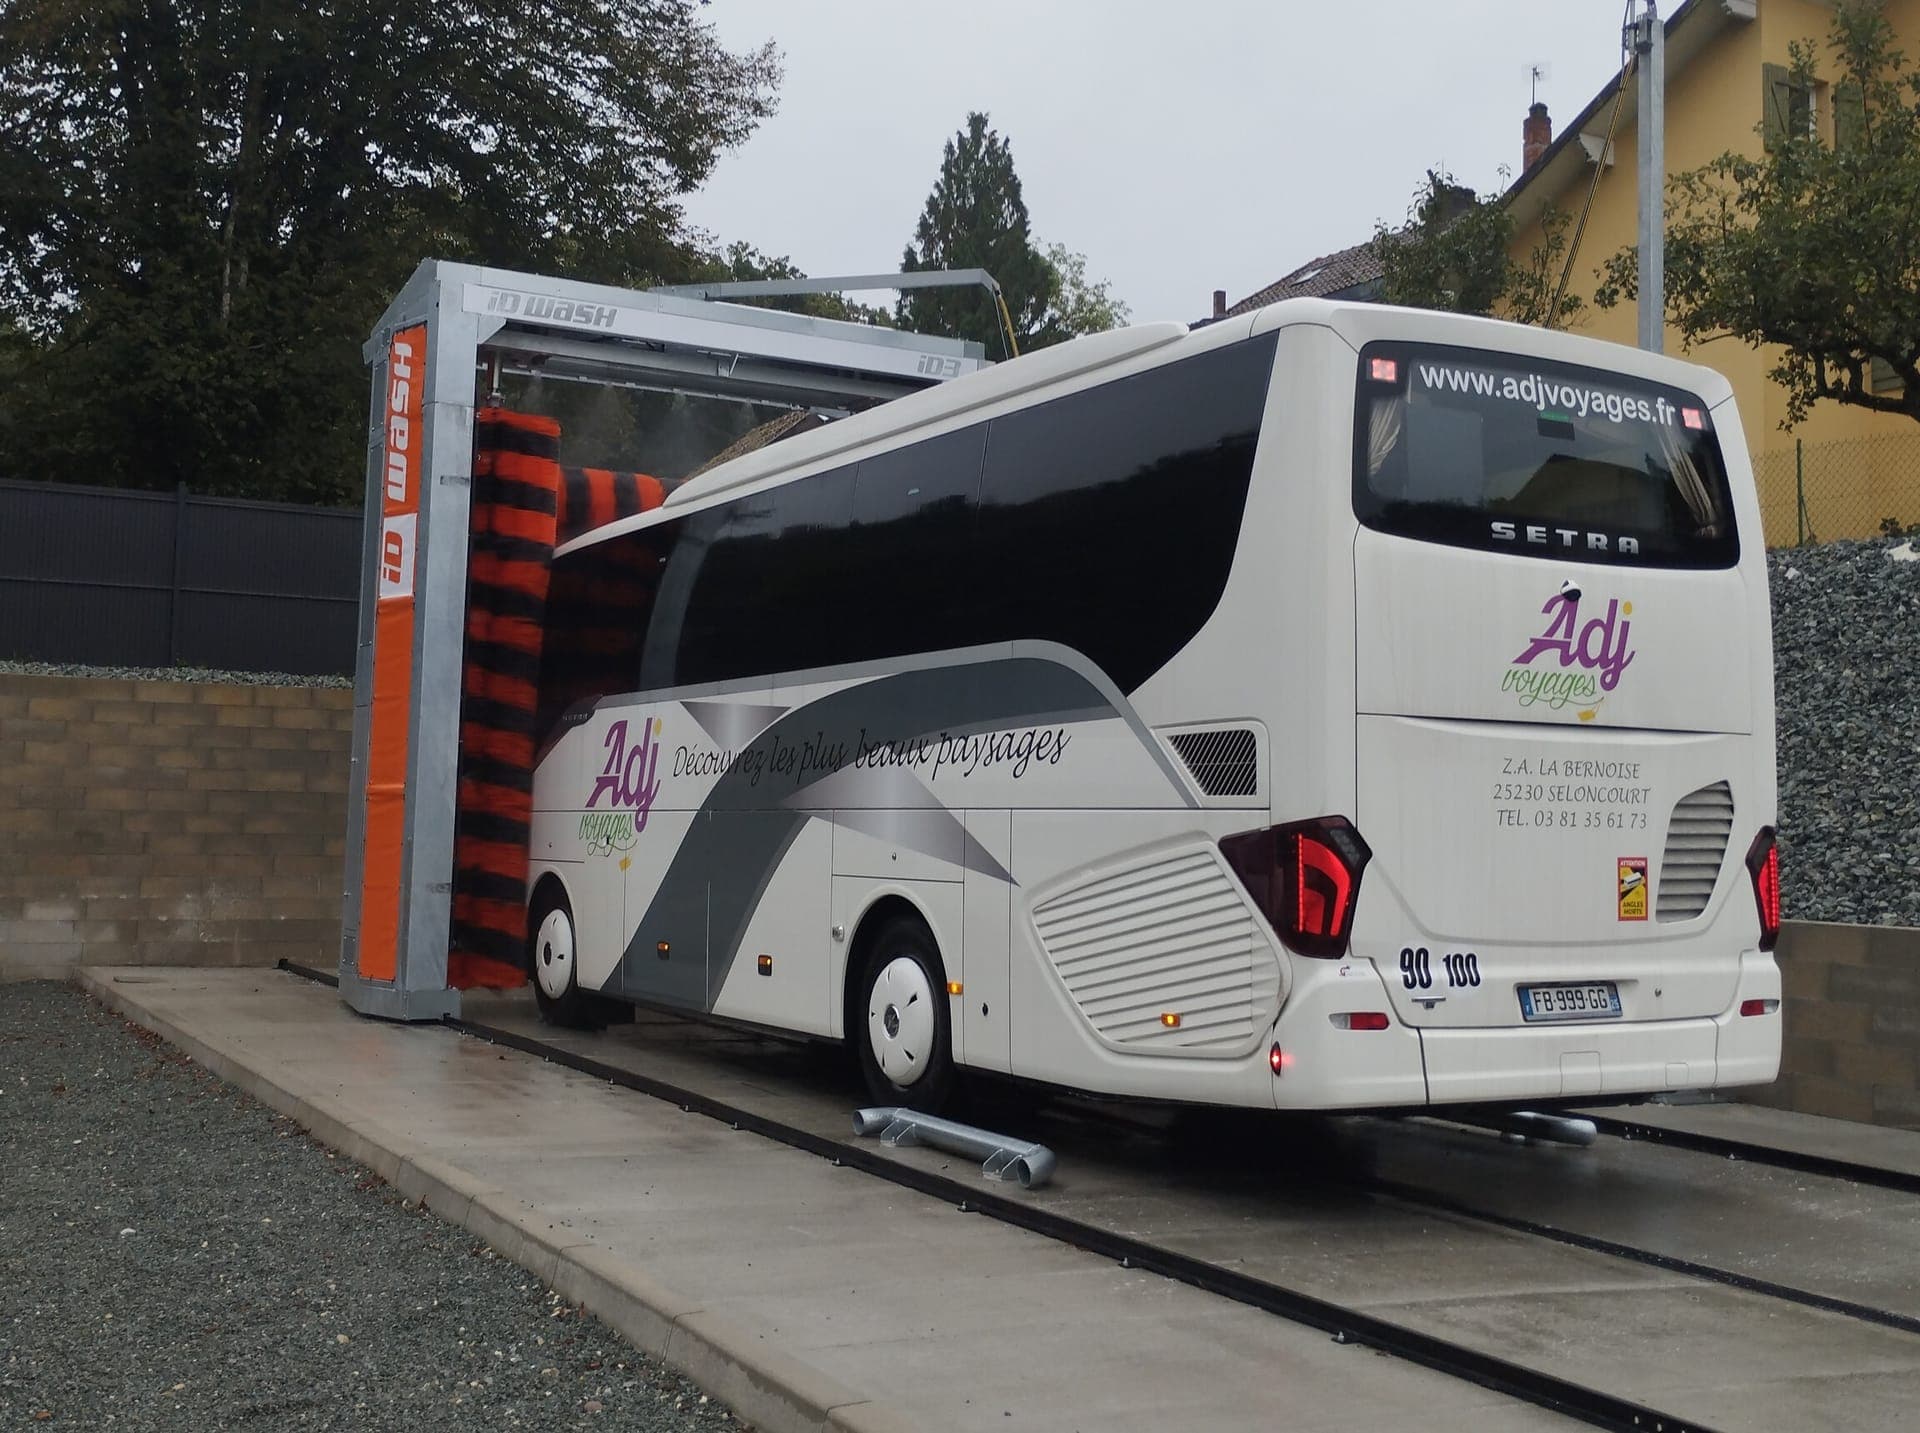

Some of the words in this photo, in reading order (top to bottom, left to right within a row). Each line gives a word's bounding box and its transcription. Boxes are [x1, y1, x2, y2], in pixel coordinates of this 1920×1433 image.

[1419, 364, 1676, 427] www.adjvoyages.fr
[1490, 521, 1640, 555] SETRA
[1512, 592, 1636, 692] Adj
[1501, 668, 1601, 710] voyages
[585, 717, 661, 833] Adj
[672, 742, 768, 786] Découvrez
[769, 735, 800, 776] les
[797, 734, 849, 785] plus
[854, 728, 936, 770] beaux
[931, 727, 1072, 781] paysages
[1502, 757, 1534, 776] Z.A.
[1539, 758, 1559, 777] LA
[1562, 760, 1641, 780] BERNOISE
[1493, 783, 1544, 801] 25230
[1546, 785, 1652, 805] SELONCOURT
[578, 812, 638, 858] voyages
[1497, 808, 1530, 827] TEL.
[1534, 809, 1554, 828] 03
[1559, 810, 1577, 828] 81
[1583, 811, 1601, 829] 35
[1606, 812, 1624, 829] 61
[1630, 812, 1647, 830] 73
[1400, 947, 1433, 990] 90
[1442, 952, 1481, 988] 100
